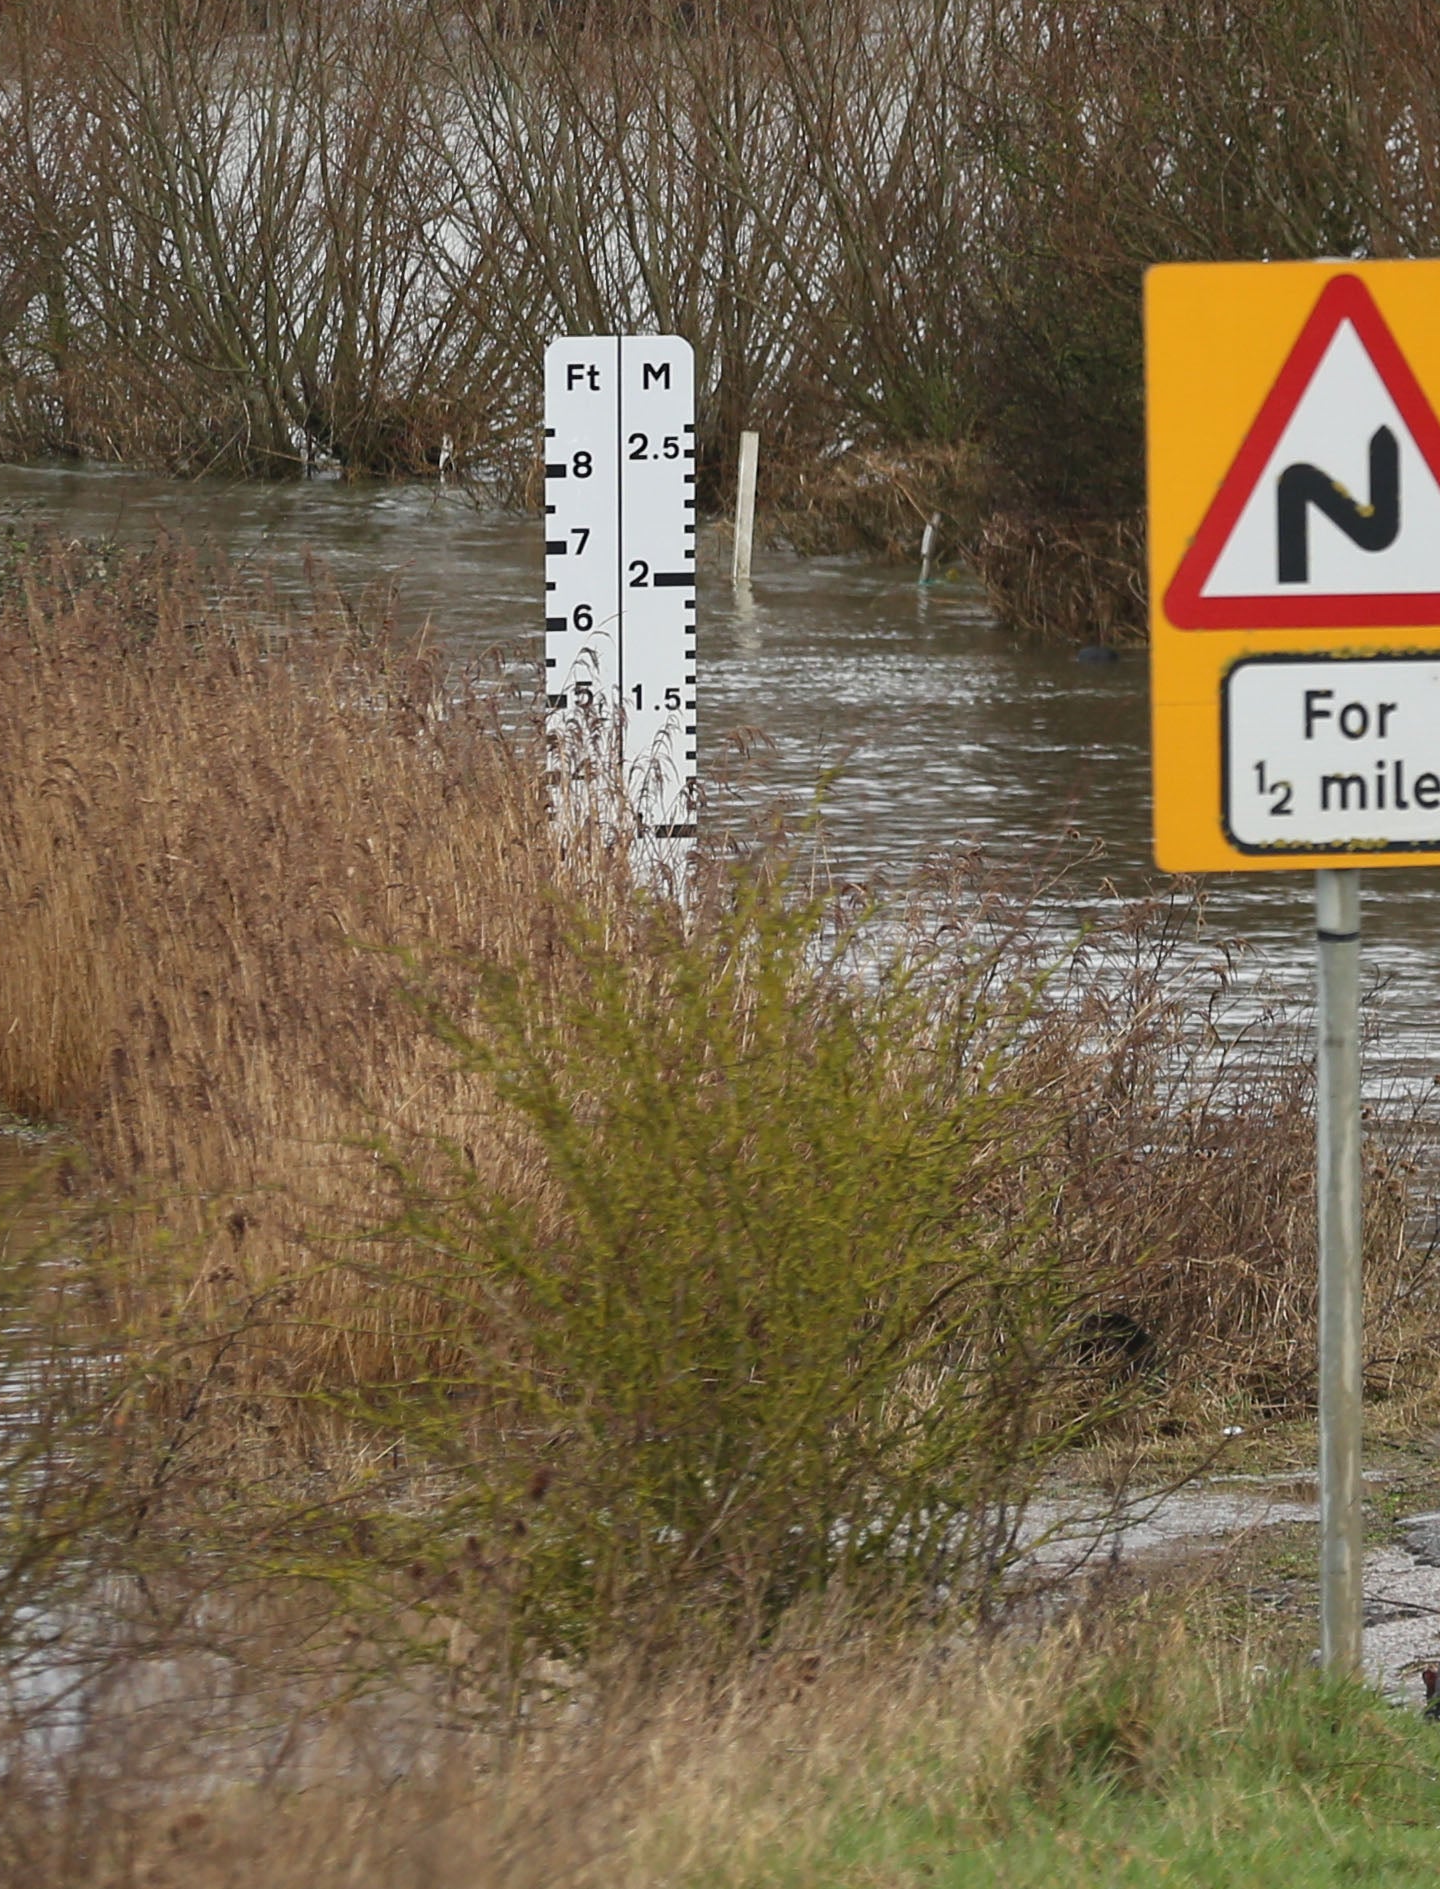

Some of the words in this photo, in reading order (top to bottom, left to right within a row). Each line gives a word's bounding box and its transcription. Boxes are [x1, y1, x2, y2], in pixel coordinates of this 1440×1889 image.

[566, 363, 601, 391] Ft
[642, 362, 671, 390] M
[628, 432, 680, 461] 2.5
[572, 450, 593, 479] 8
[570, 528, 590, 556] 7
[628, 560, 649, 588] 2
[572, 603, 594, 632] 6
[574, 681, 595, 708] 5
[631, 683, 681, 711] 1.5
[1304, 689, 1397, 740] For
